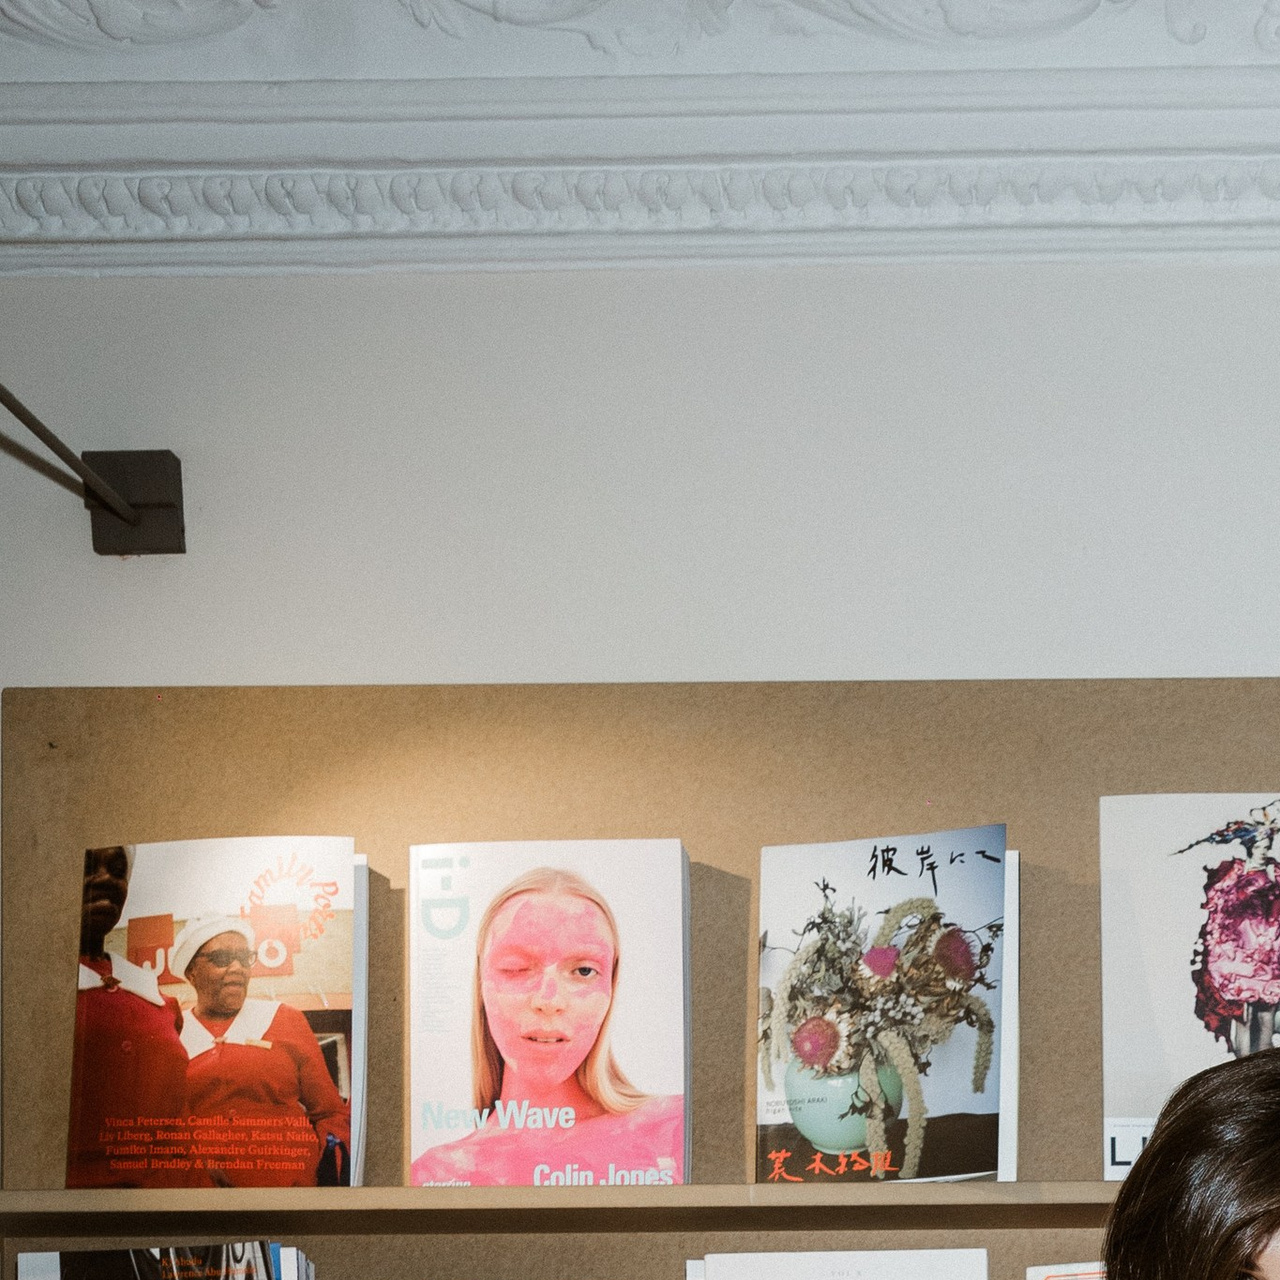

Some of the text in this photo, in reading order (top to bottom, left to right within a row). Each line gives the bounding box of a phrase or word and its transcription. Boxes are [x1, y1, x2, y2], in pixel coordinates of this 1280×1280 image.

[187, 1115, 230, 1126] Camille
[421, 1099, 576, 1130] New Wave
[156, 1131, 191, 1141] Ronan
[190, 1144, 246, 1155] Alexandre
[110, 1158, 305, 1172] Samuel Bradley & Brendan Freeman
[533, 1163, 594, 1186] Colin
[600, 1163, 674, 1186] Jones
